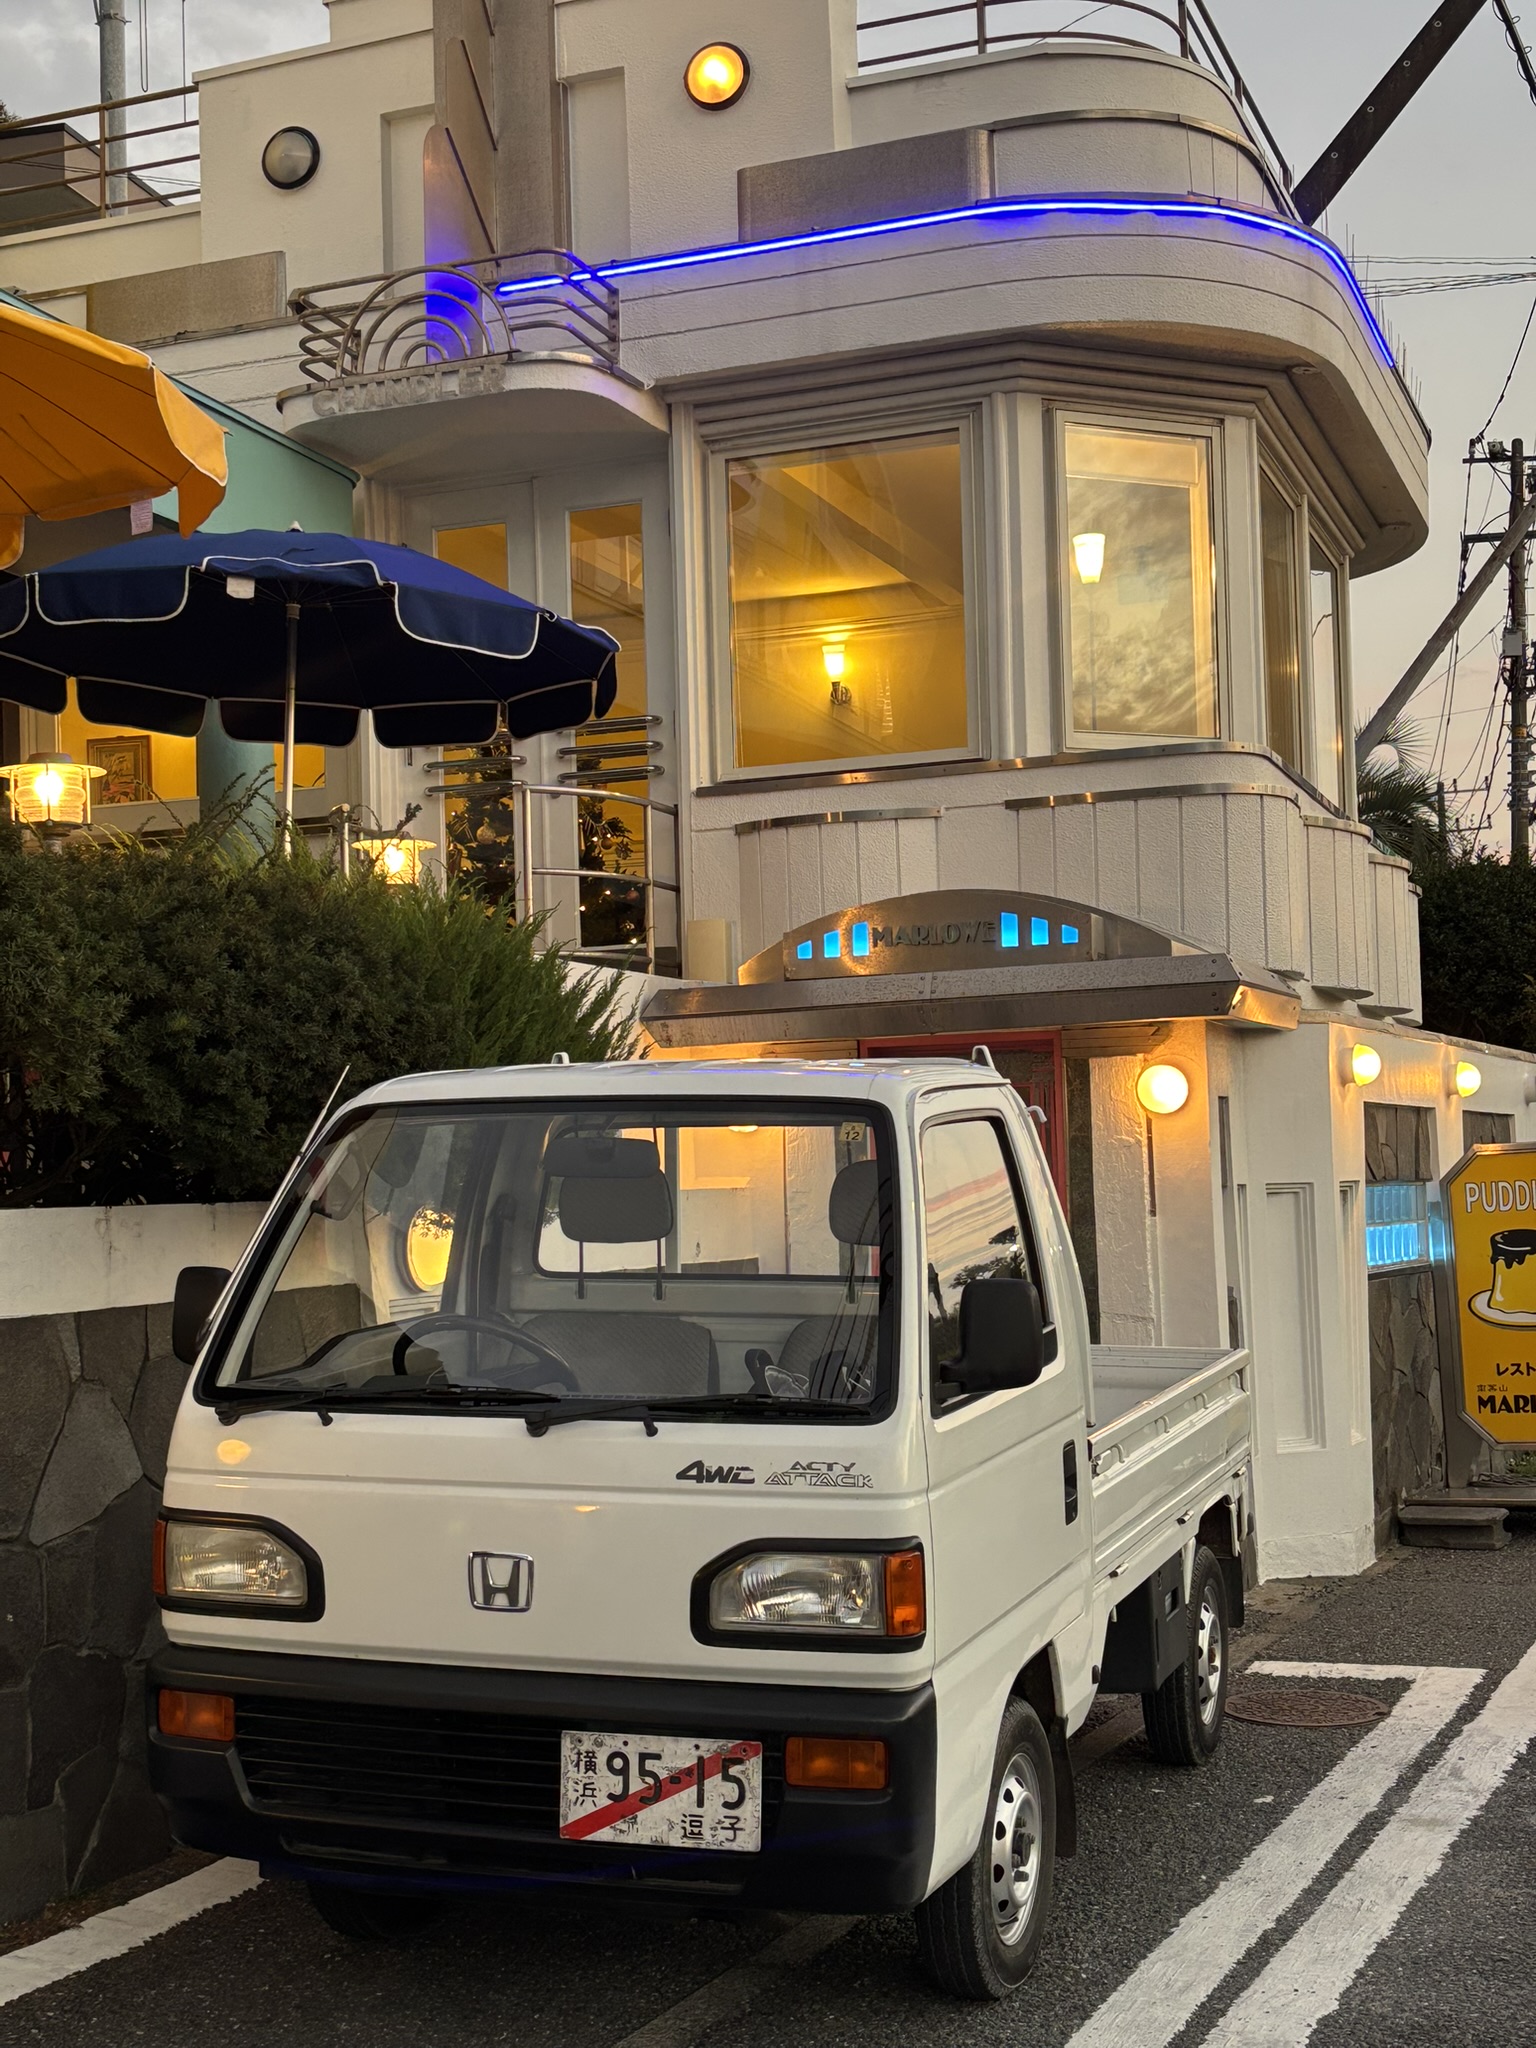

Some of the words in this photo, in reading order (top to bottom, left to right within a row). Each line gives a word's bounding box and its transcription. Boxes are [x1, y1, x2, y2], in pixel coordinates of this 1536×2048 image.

[312, 363, 506, 417] CHANDLER
[872, 921, 996, 948] MARLOWE
[844, 1131, 860, 1141] 12
[764, 1472, 874, 1488] ATTACK
[790, 1461, 856, 1472] ACTY
[573, 1749, 598, 1808] 横浜
[606, 1751, 746, 1810] 95-15
